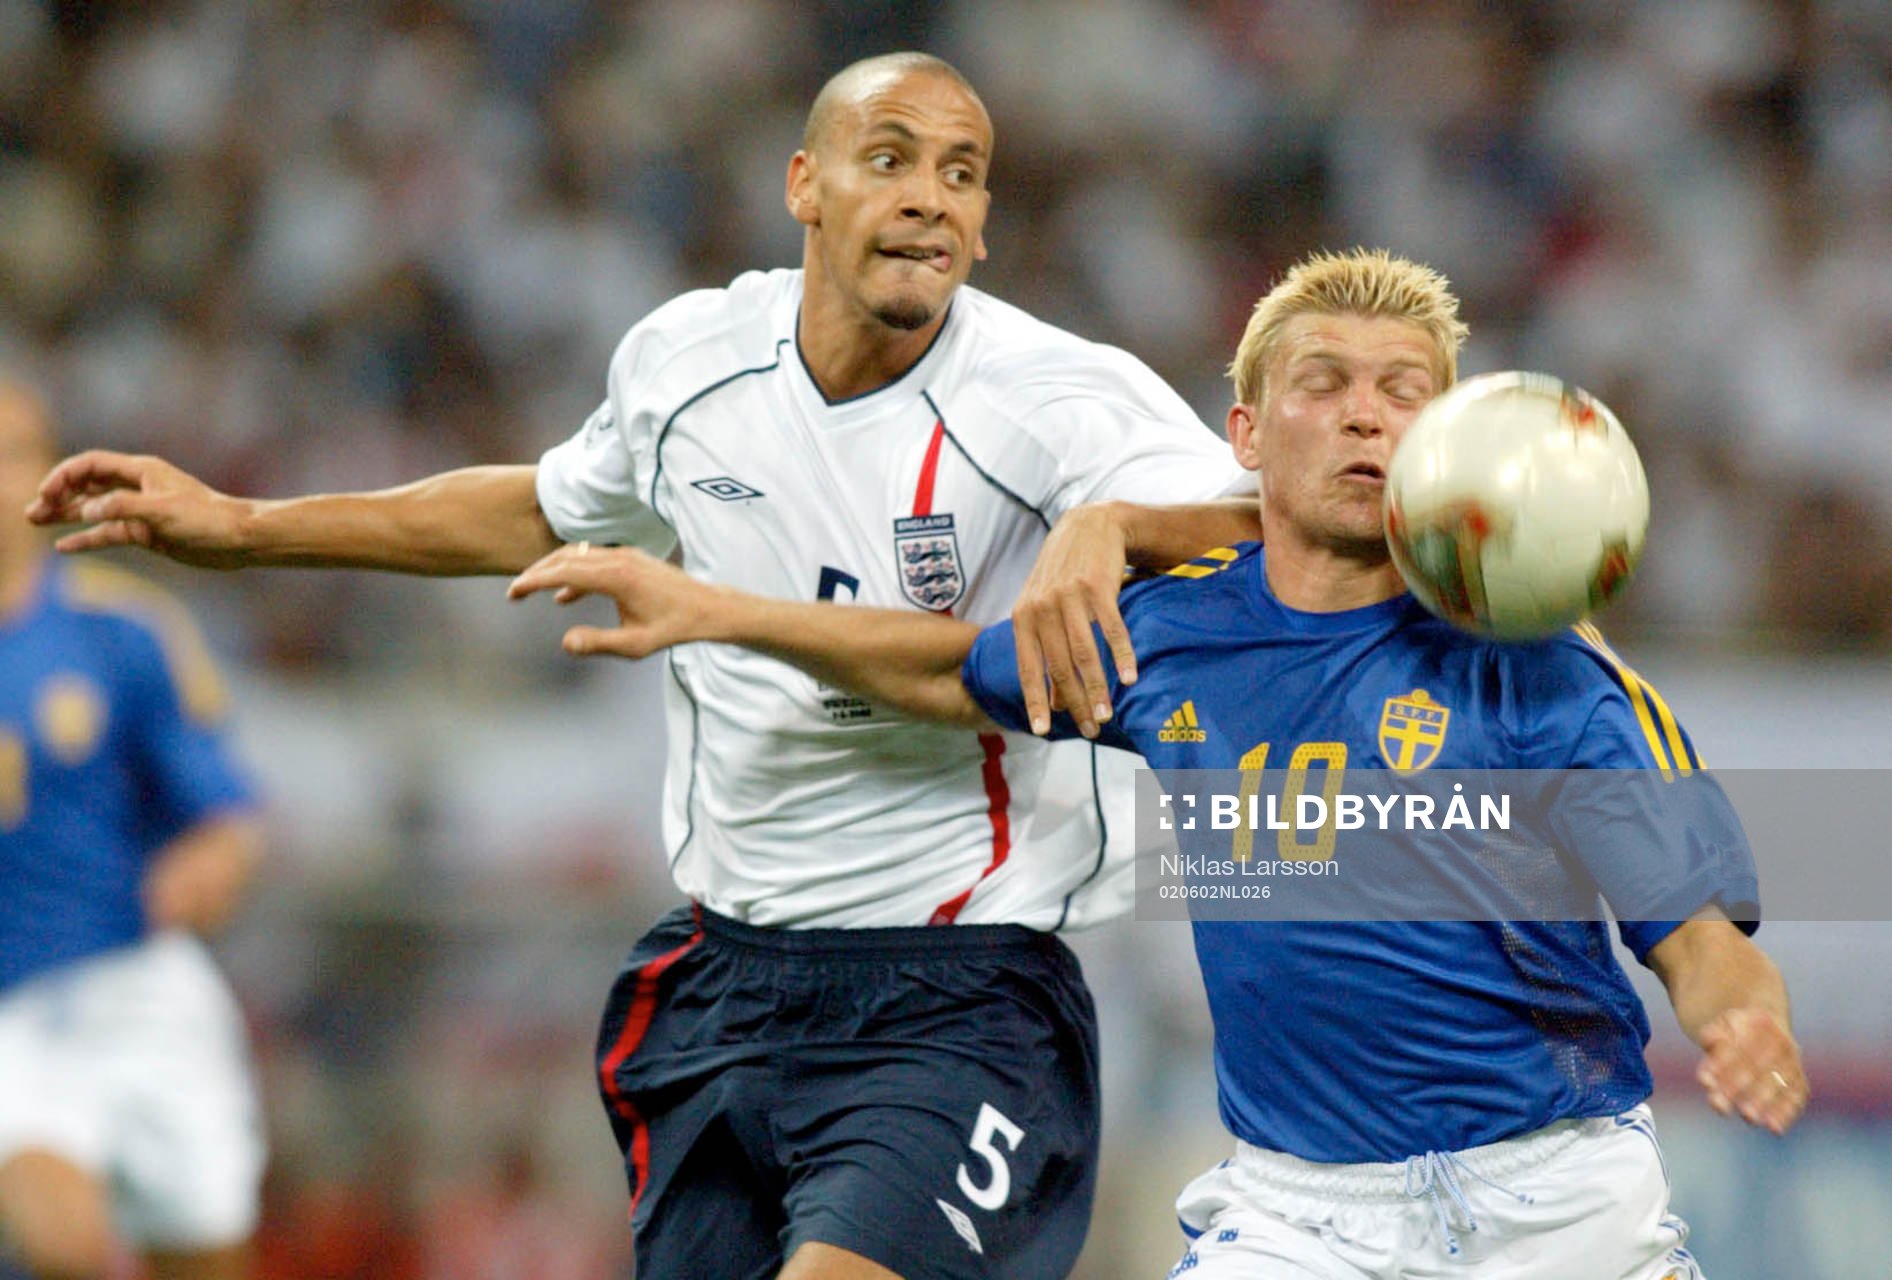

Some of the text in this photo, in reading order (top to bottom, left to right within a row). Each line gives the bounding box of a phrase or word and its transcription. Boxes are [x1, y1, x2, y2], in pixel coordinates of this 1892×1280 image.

[897, 516, 951, 531] ENGLAND
[1158, 729, 1206, 742] adidas
[1231, 741, 1348, 862] 10
[956, 1102, 1026, 1210] 5
